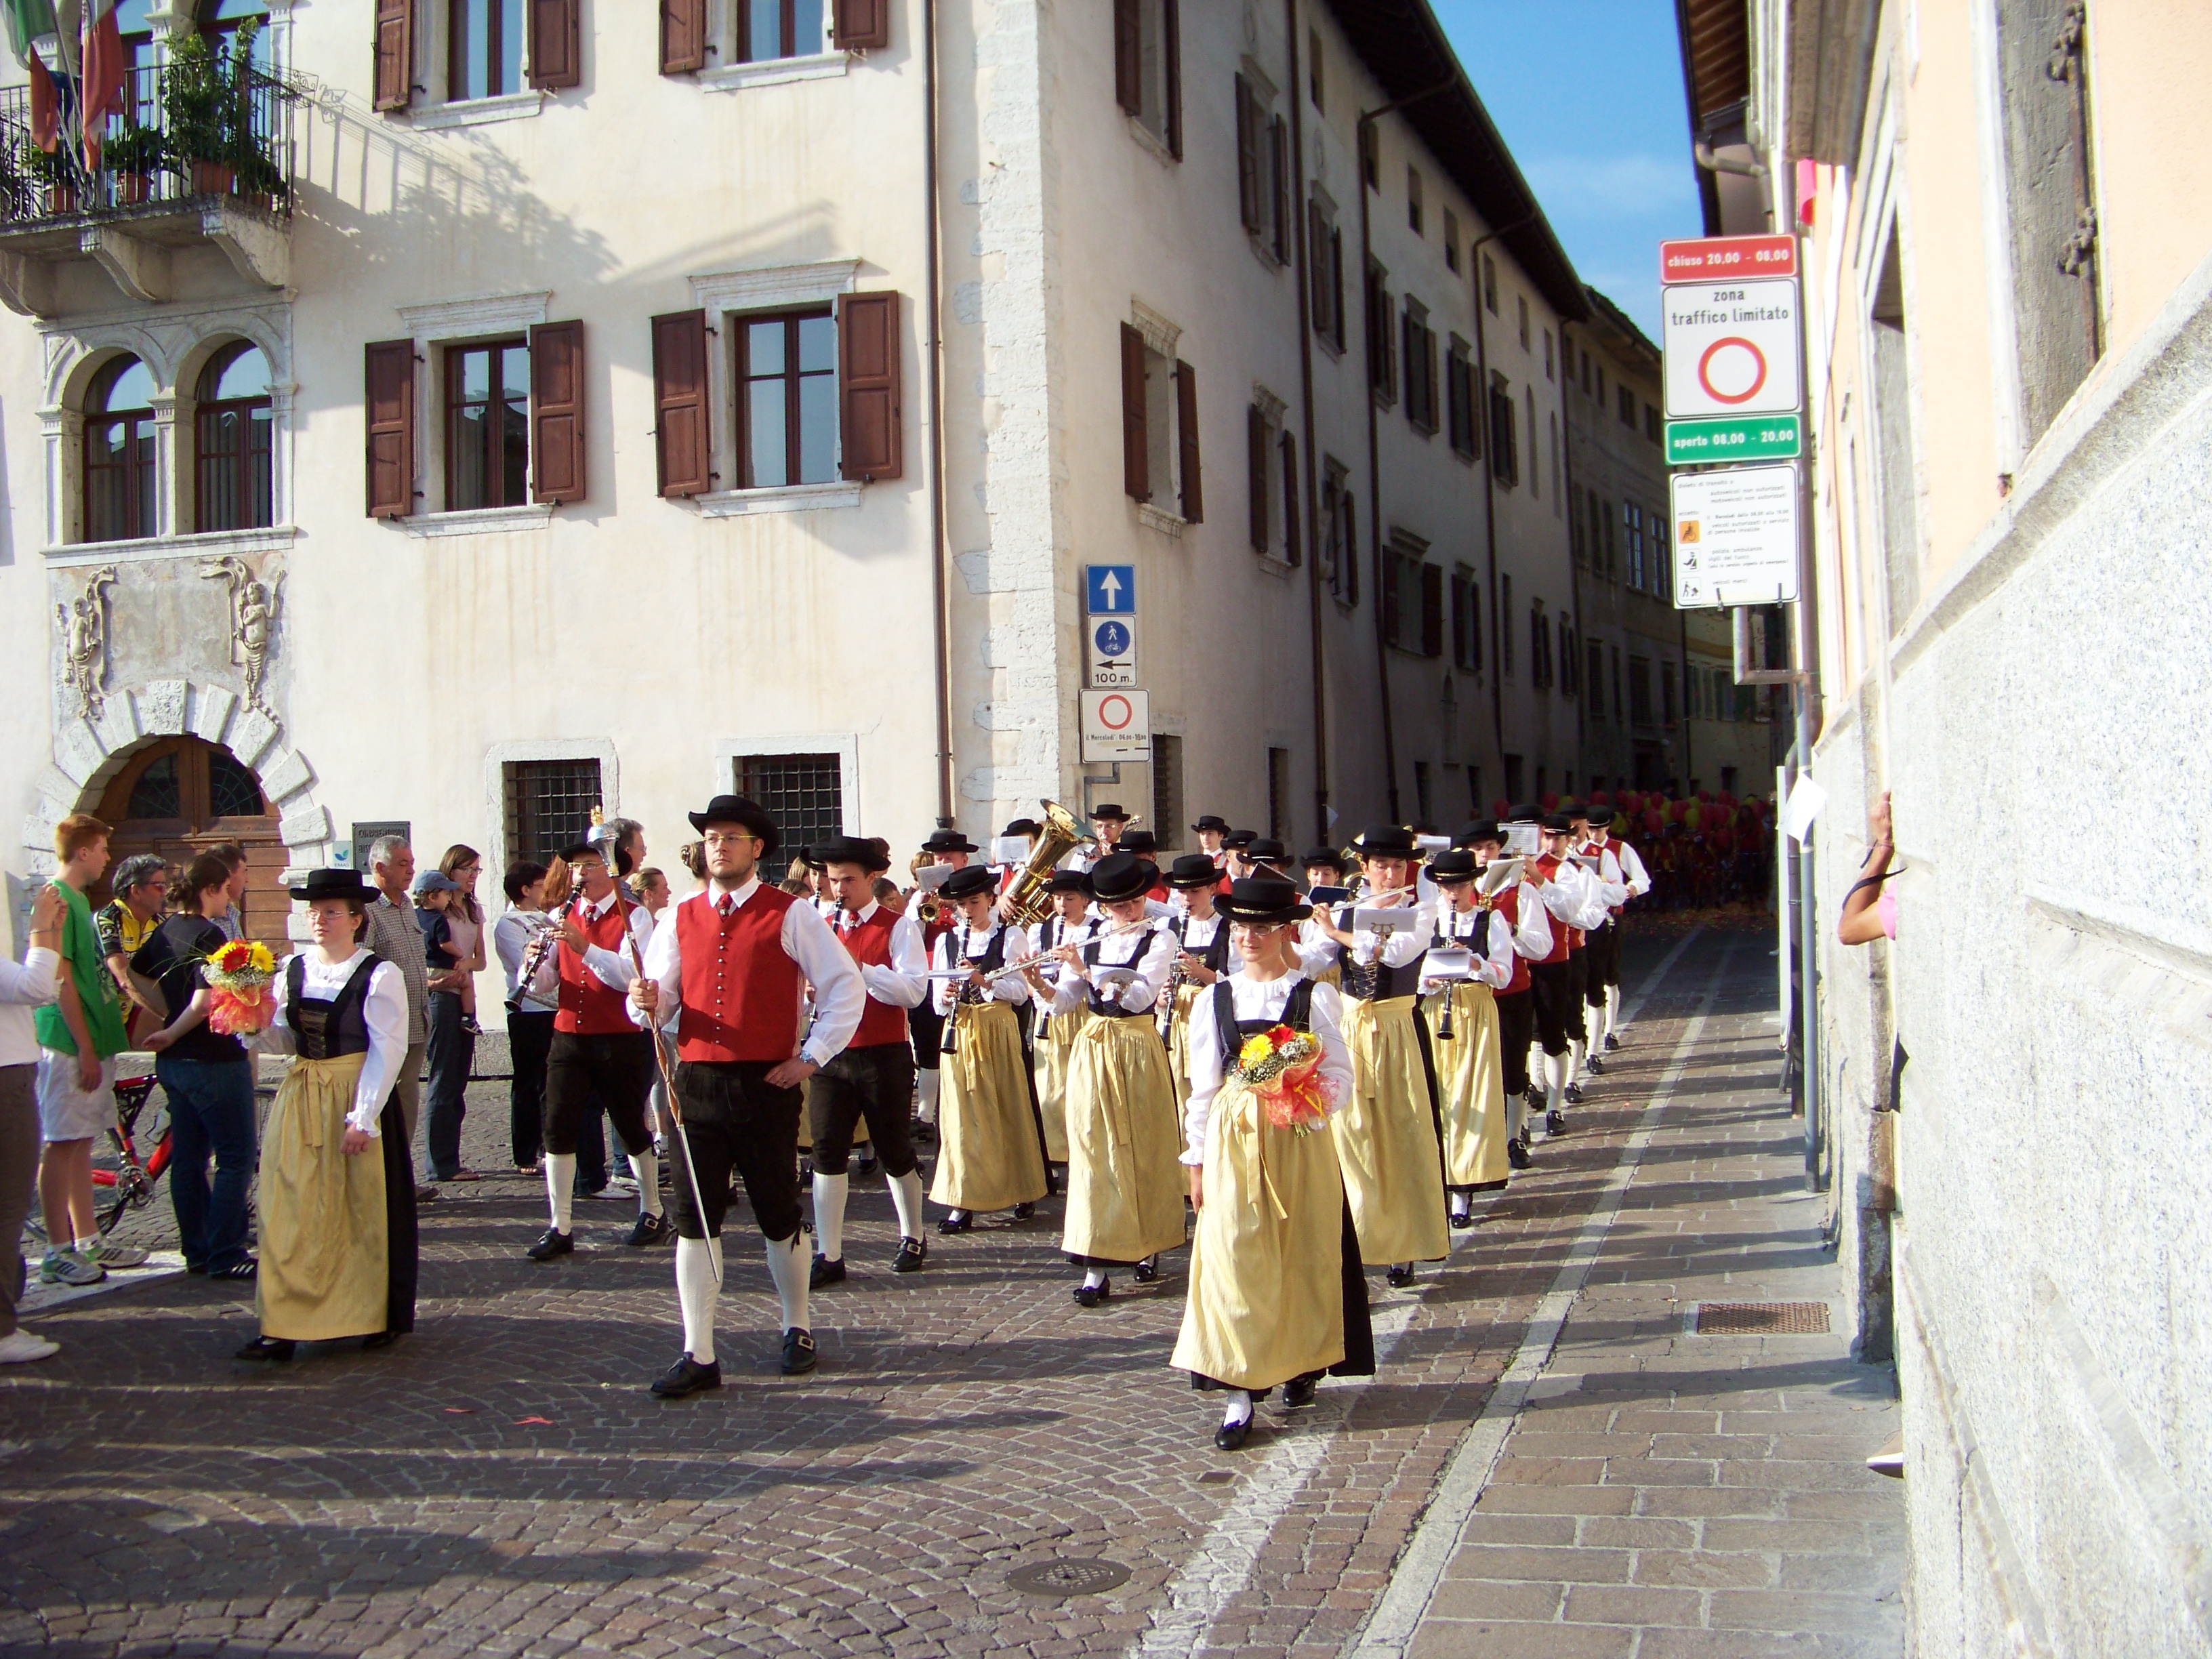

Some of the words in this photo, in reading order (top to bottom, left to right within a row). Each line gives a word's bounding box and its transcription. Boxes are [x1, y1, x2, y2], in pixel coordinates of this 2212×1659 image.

[1668, 255, 1702, 267] chiuso
[1707, 252, 1740, 265] 20.00
[1755, 249, 1789, 262] 08.00
[1713, 290, 1745, 302] zona
[1672, 308, 1727, 326] traffico
[1732, 306, 1789, 323] limitato
[1674, 436, 1708, 449] aperto
[1713, 433, 1746, 446] 08.00
[1761, 430, 1794, 443] 20.00
[1094, 673, 1117, 684] 100
[1120, 675, 1132, 683] m.
